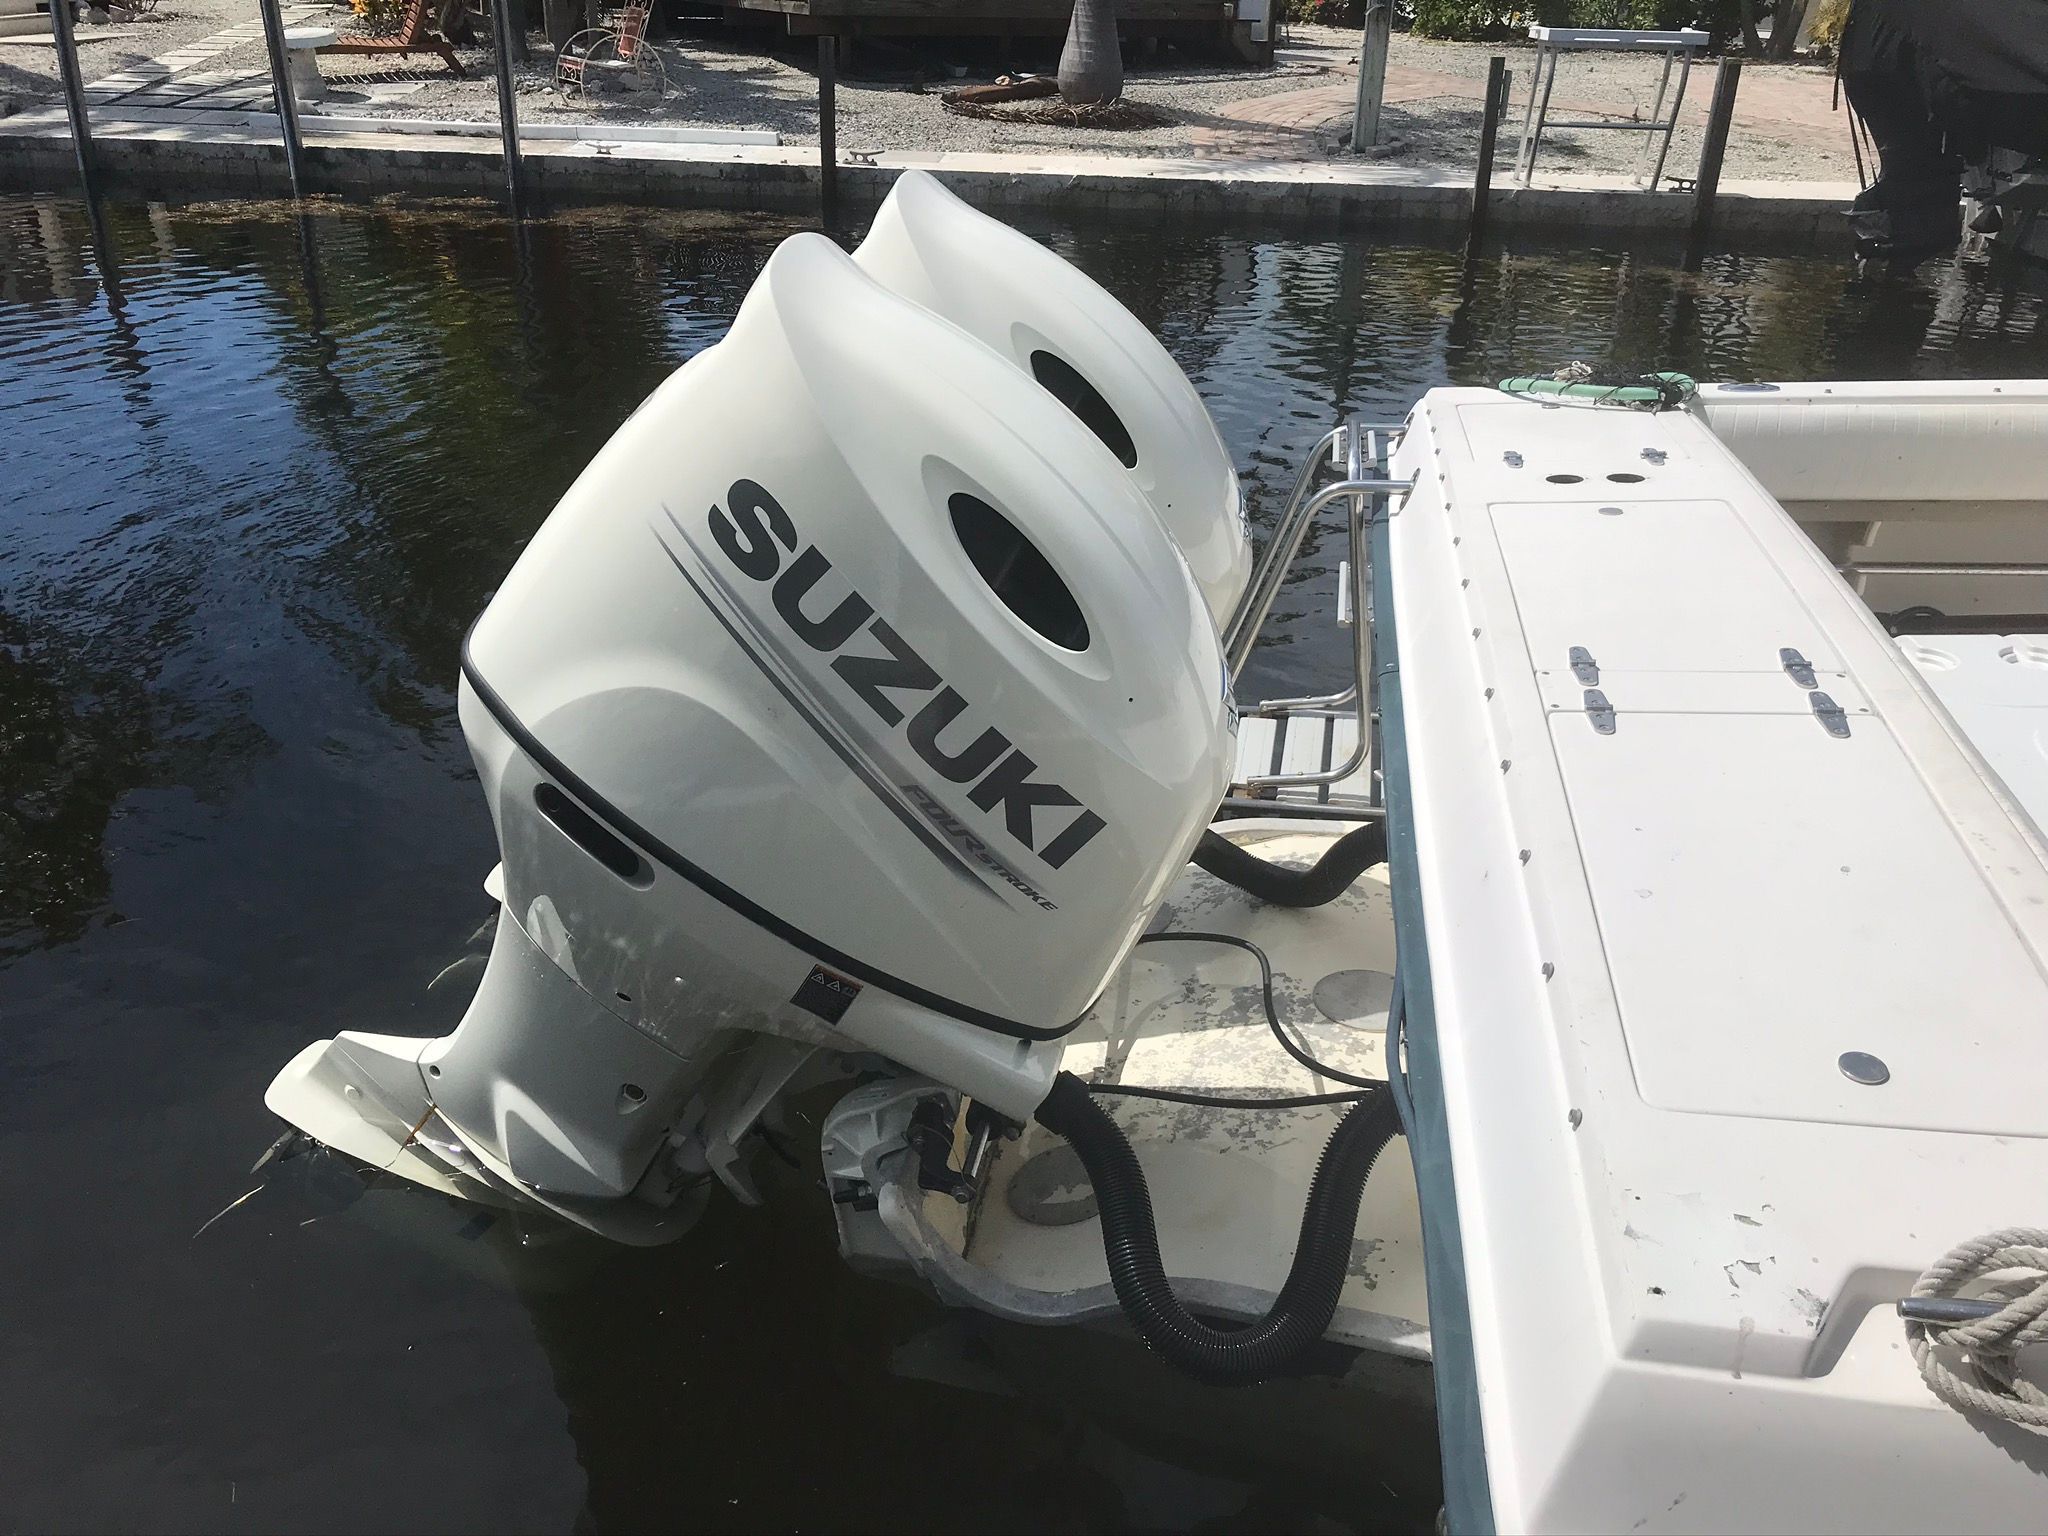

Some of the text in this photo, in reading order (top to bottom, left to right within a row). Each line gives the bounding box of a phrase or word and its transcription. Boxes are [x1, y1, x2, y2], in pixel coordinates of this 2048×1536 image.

[708, 478, 1107, 870] SUZUKI
[900, 785, 1058, 911] FOUR STROKE
